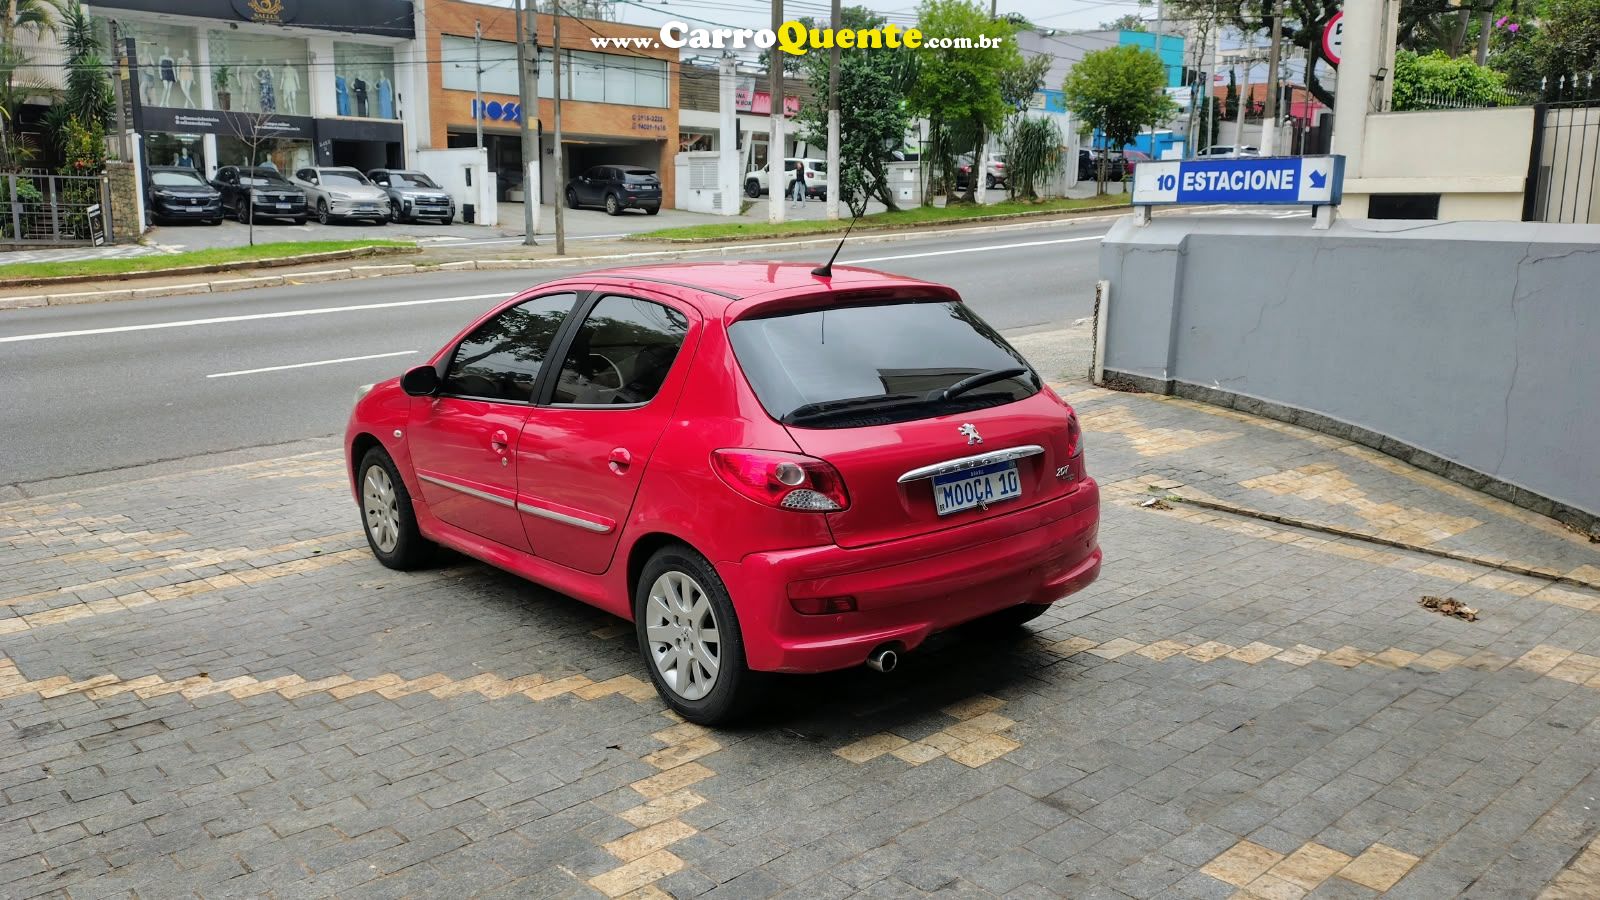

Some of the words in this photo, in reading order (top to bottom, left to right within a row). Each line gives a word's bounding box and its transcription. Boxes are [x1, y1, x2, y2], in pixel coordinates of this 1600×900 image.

[1157, 175, 1176, 191] 10
[1182, 169, 1295, 192] ESTACIONE
[1056, 465, 1070, 476] 207
[943, 477, 994, 509] MOOCA
[999, 471, 1018, 495] 10
